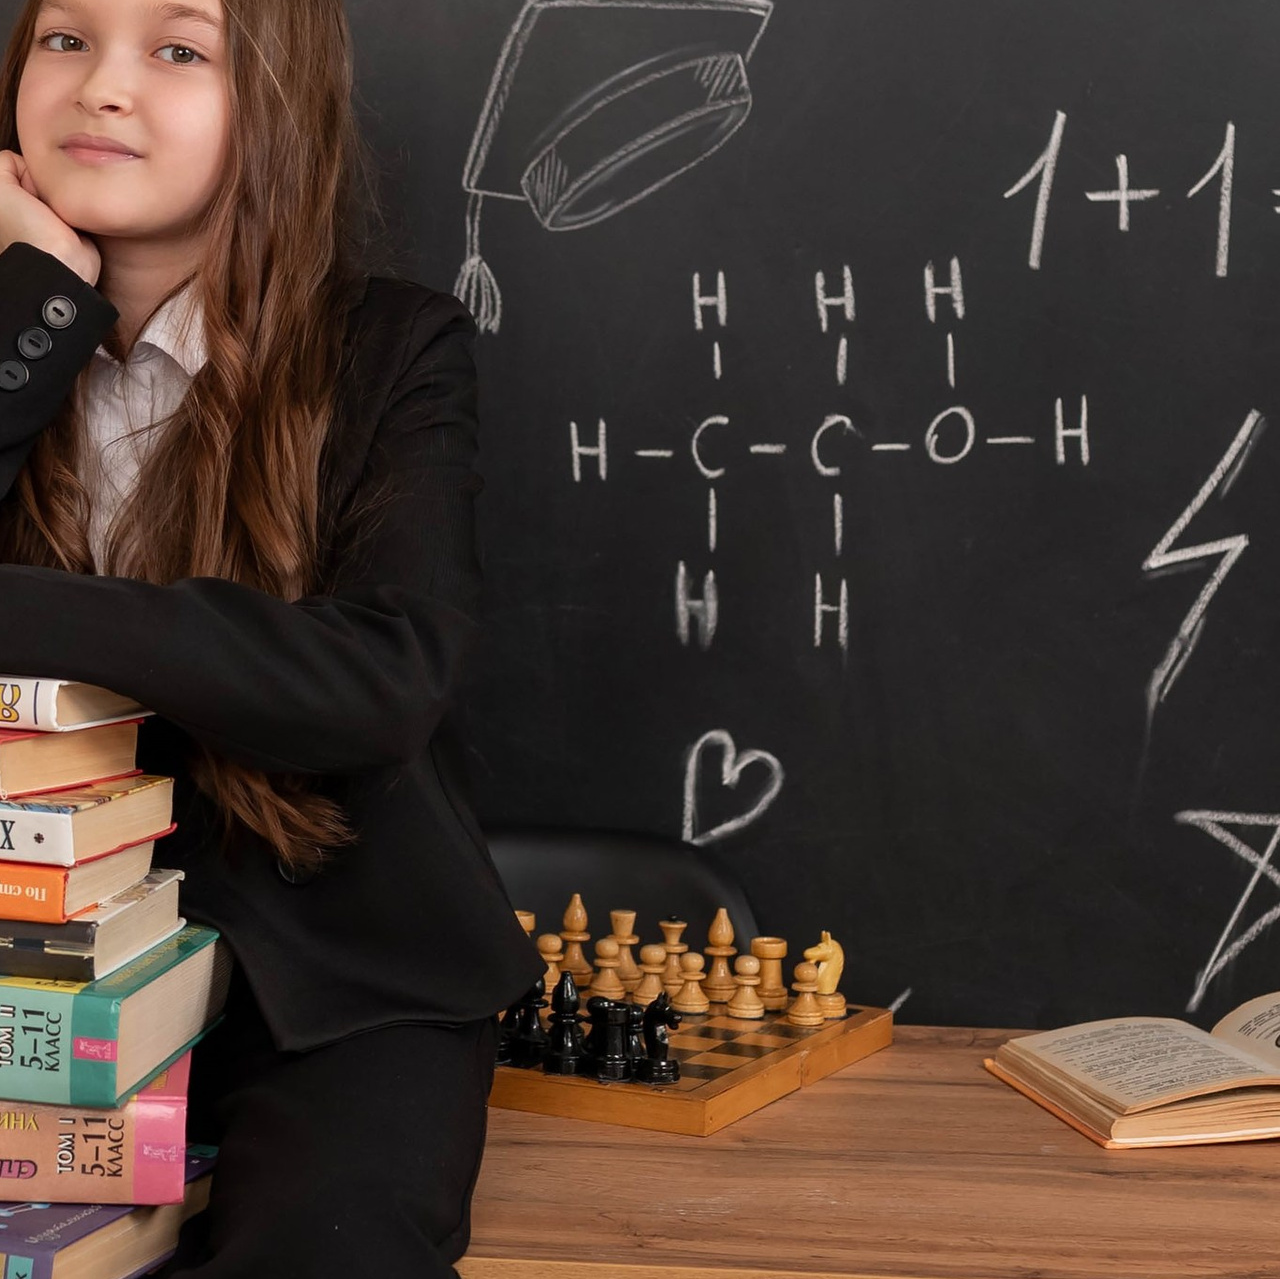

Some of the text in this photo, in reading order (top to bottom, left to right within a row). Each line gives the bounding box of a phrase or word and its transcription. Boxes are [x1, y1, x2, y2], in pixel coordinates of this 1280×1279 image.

[25, 886, 47, 902] По
[44, 1011, 62, 1072] КЛАСС
[56, 1132, 78, 1174] ТОМ
[106, 1118, 125, 1178] КЛАСС
